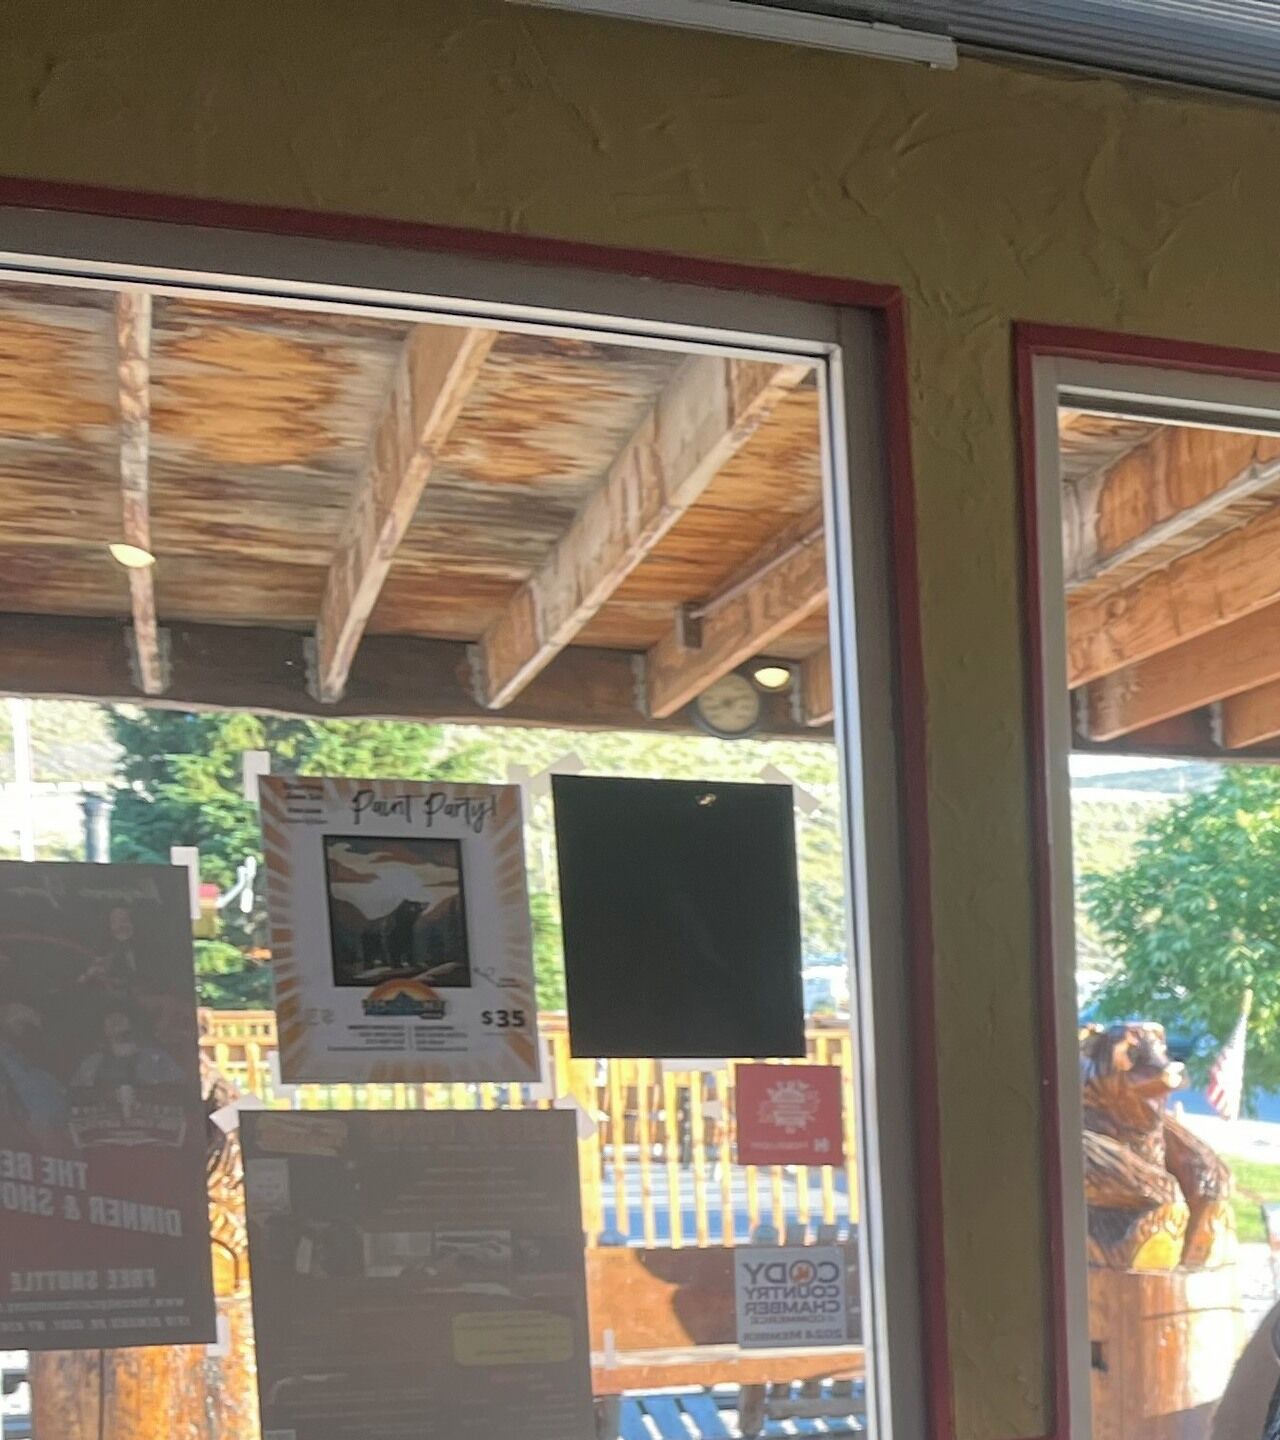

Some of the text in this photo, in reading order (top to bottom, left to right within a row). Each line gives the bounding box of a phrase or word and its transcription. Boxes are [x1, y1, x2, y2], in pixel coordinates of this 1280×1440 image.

[352, 789, 424, 826] Paint
[424, 791, 497, 834] Party!
[481, 1009, 526, 1029] $35
